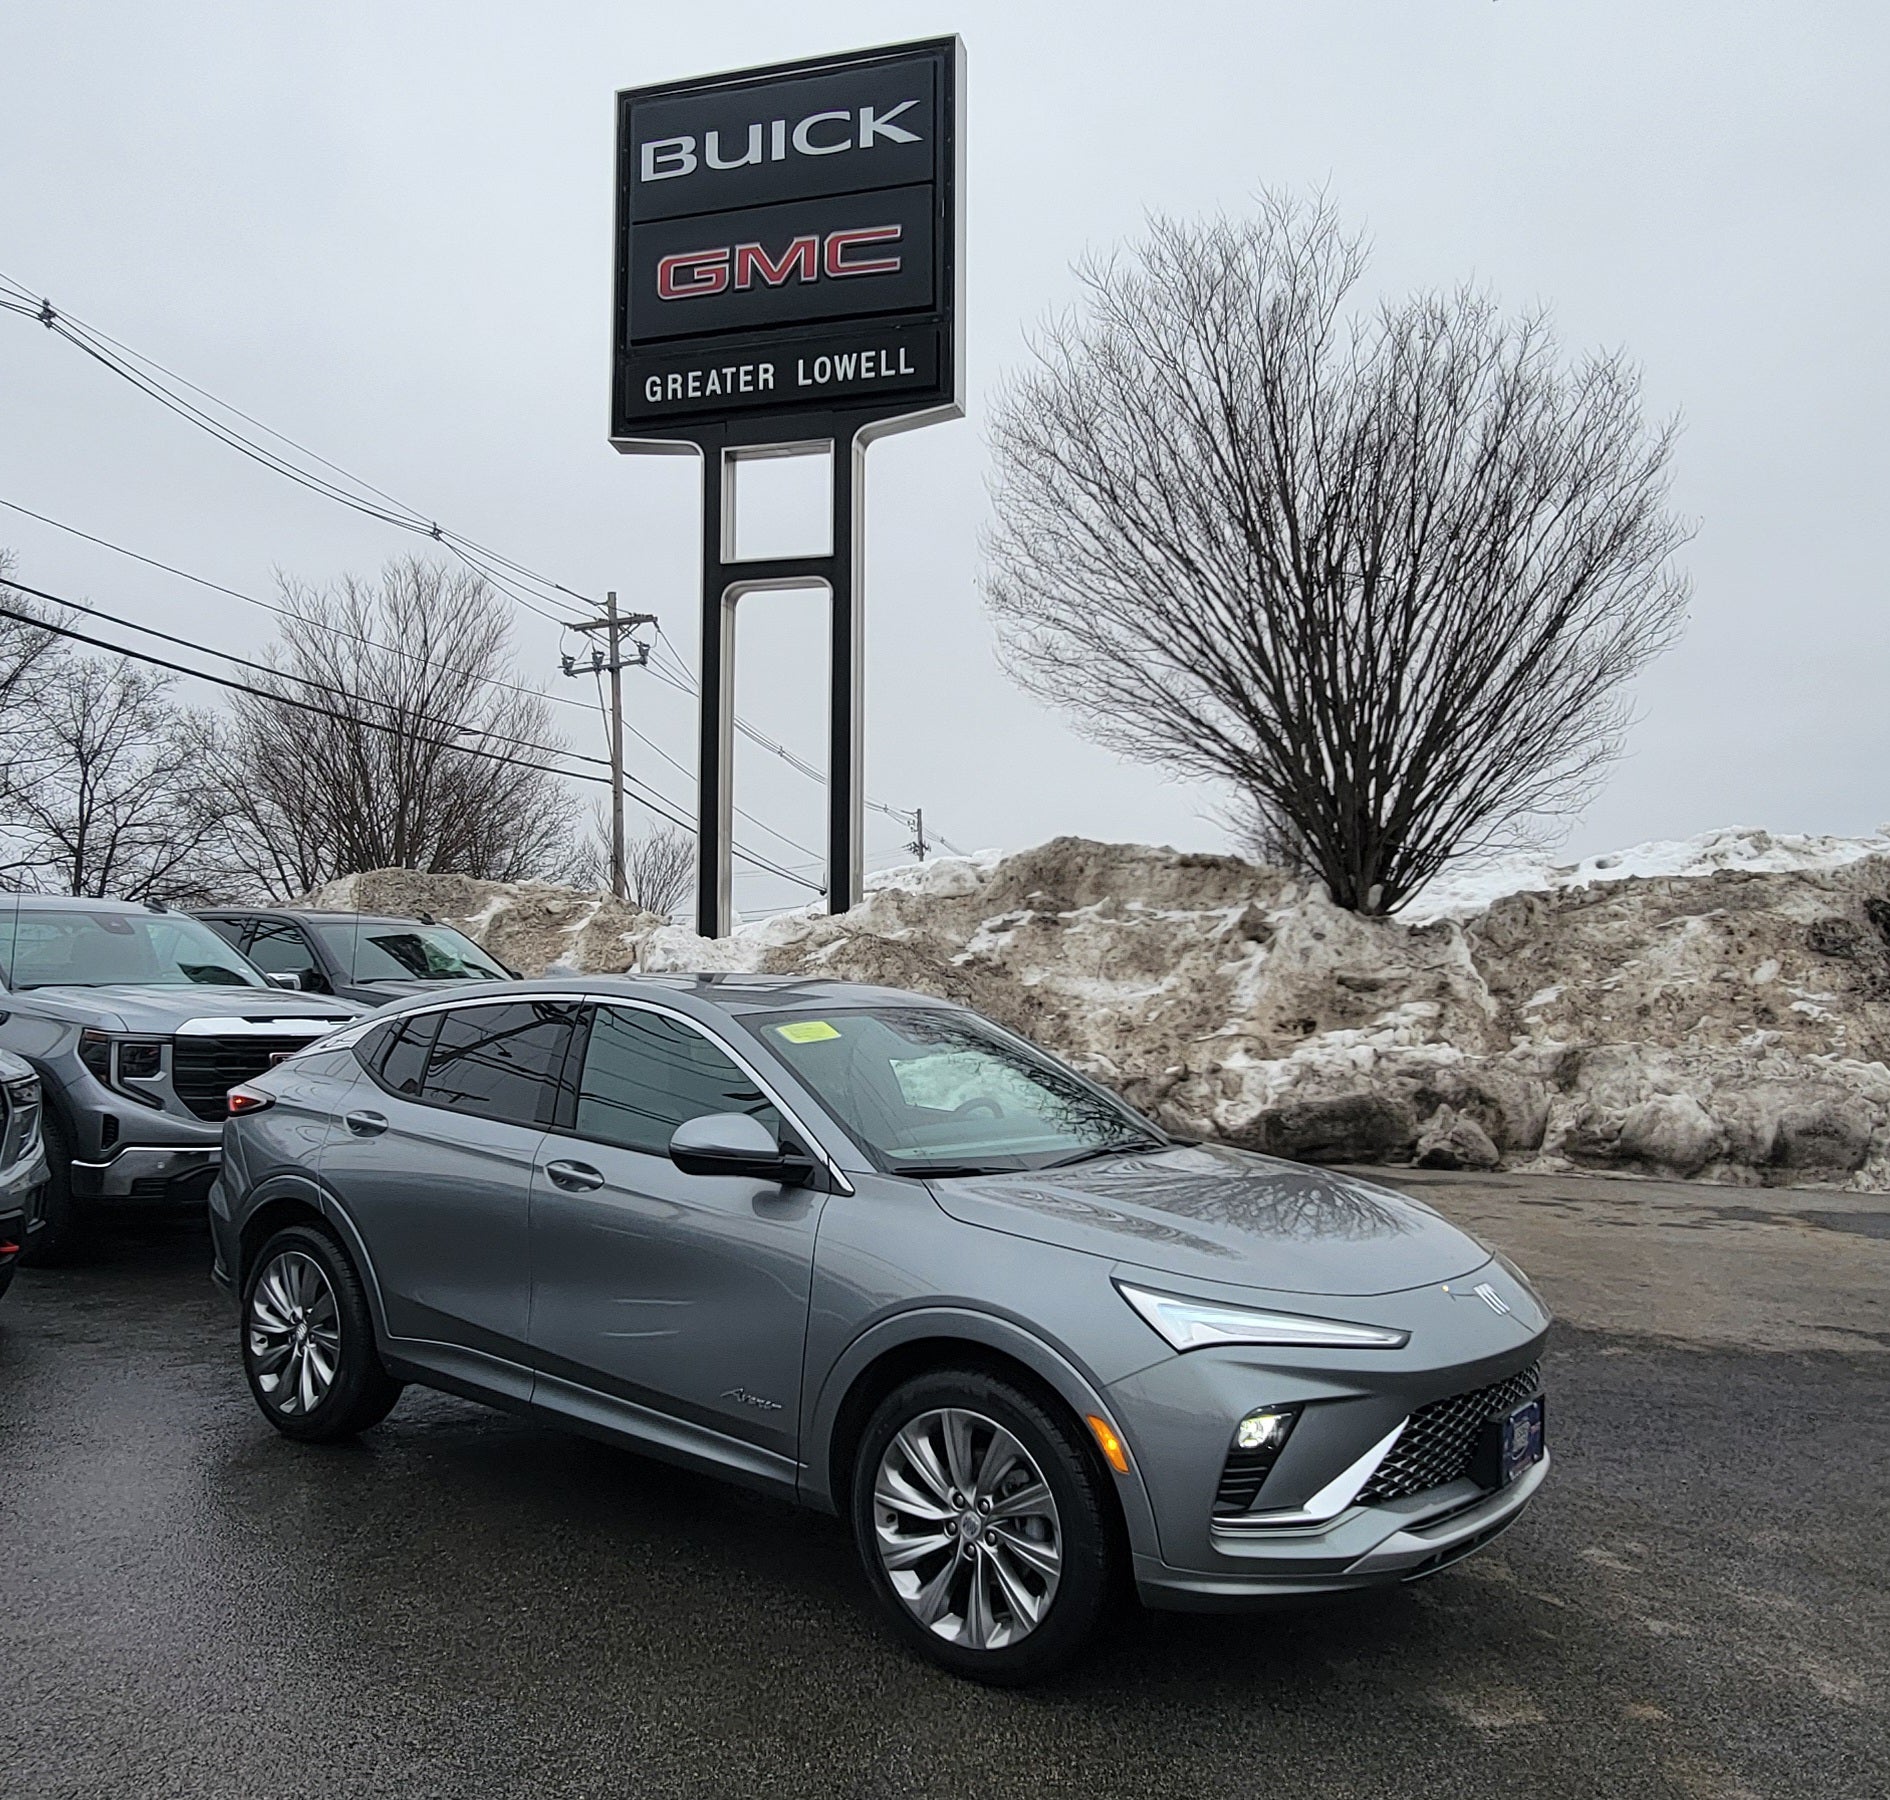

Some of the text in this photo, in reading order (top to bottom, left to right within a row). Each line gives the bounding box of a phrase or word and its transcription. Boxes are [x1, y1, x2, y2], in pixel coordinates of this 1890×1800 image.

[640, 100, 924, 182] BUICK
[657, 224, 902, 300] GMC
[645, 347, 915, 402] GREATER LOWELL
